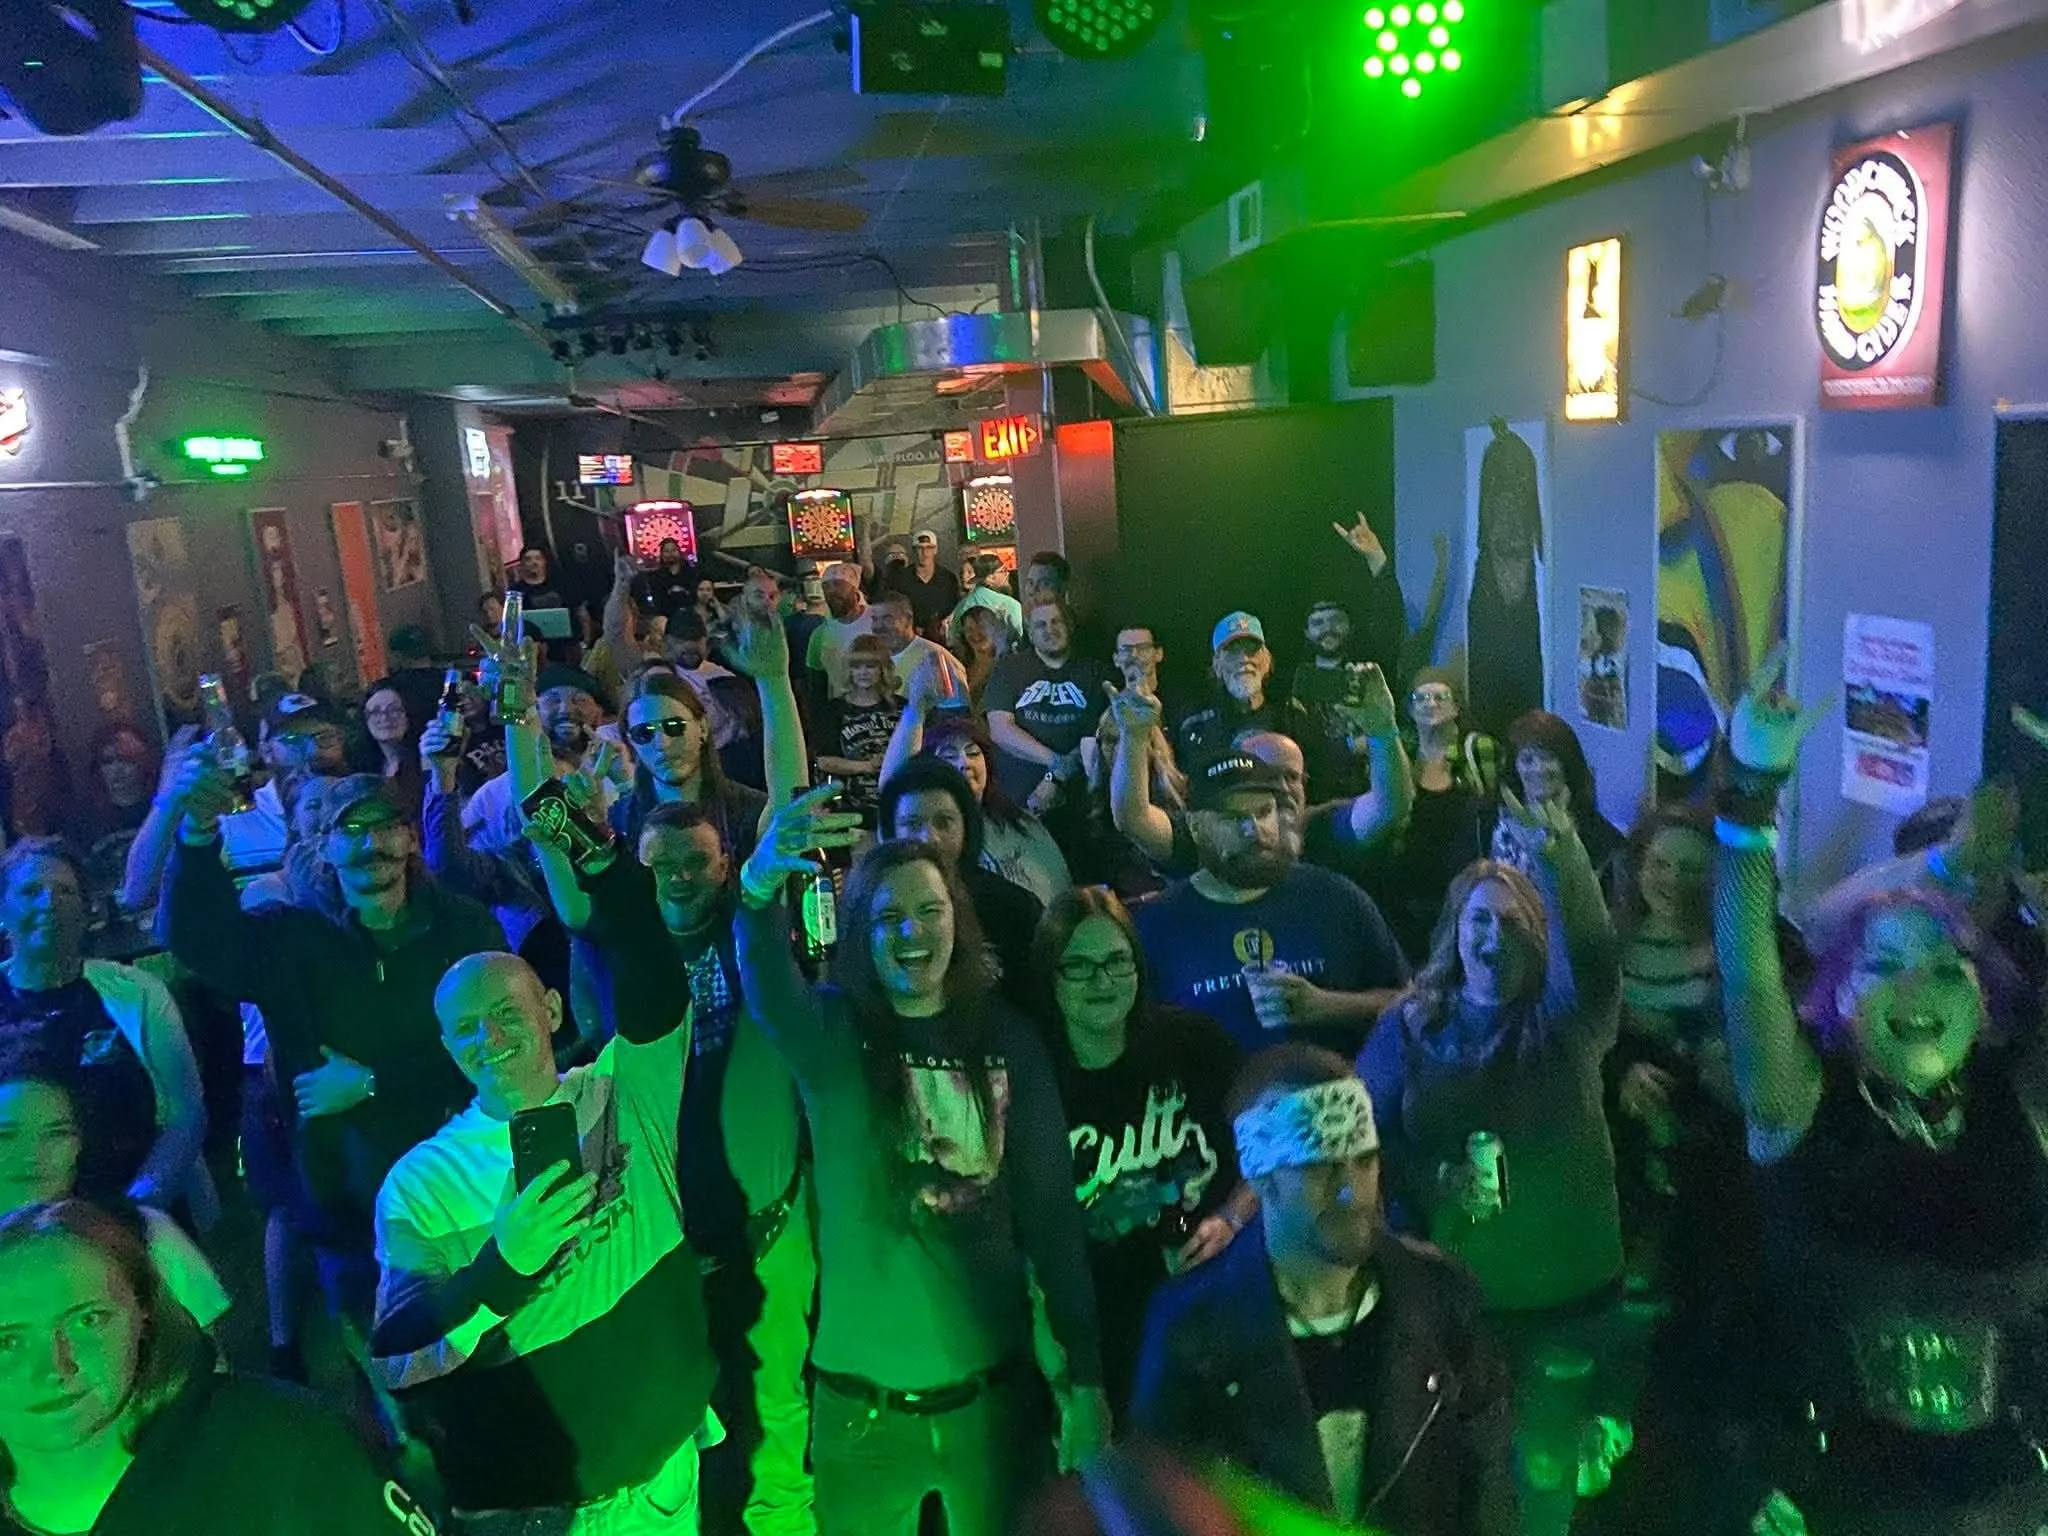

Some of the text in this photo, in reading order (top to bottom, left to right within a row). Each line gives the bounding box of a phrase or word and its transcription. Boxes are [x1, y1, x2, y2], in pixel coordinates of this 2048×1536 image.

[1821, 159, 1916, 262] WOODCCK
[981, 414, 1030, 460] EXIT
[555, 479, 587, 500] 11
